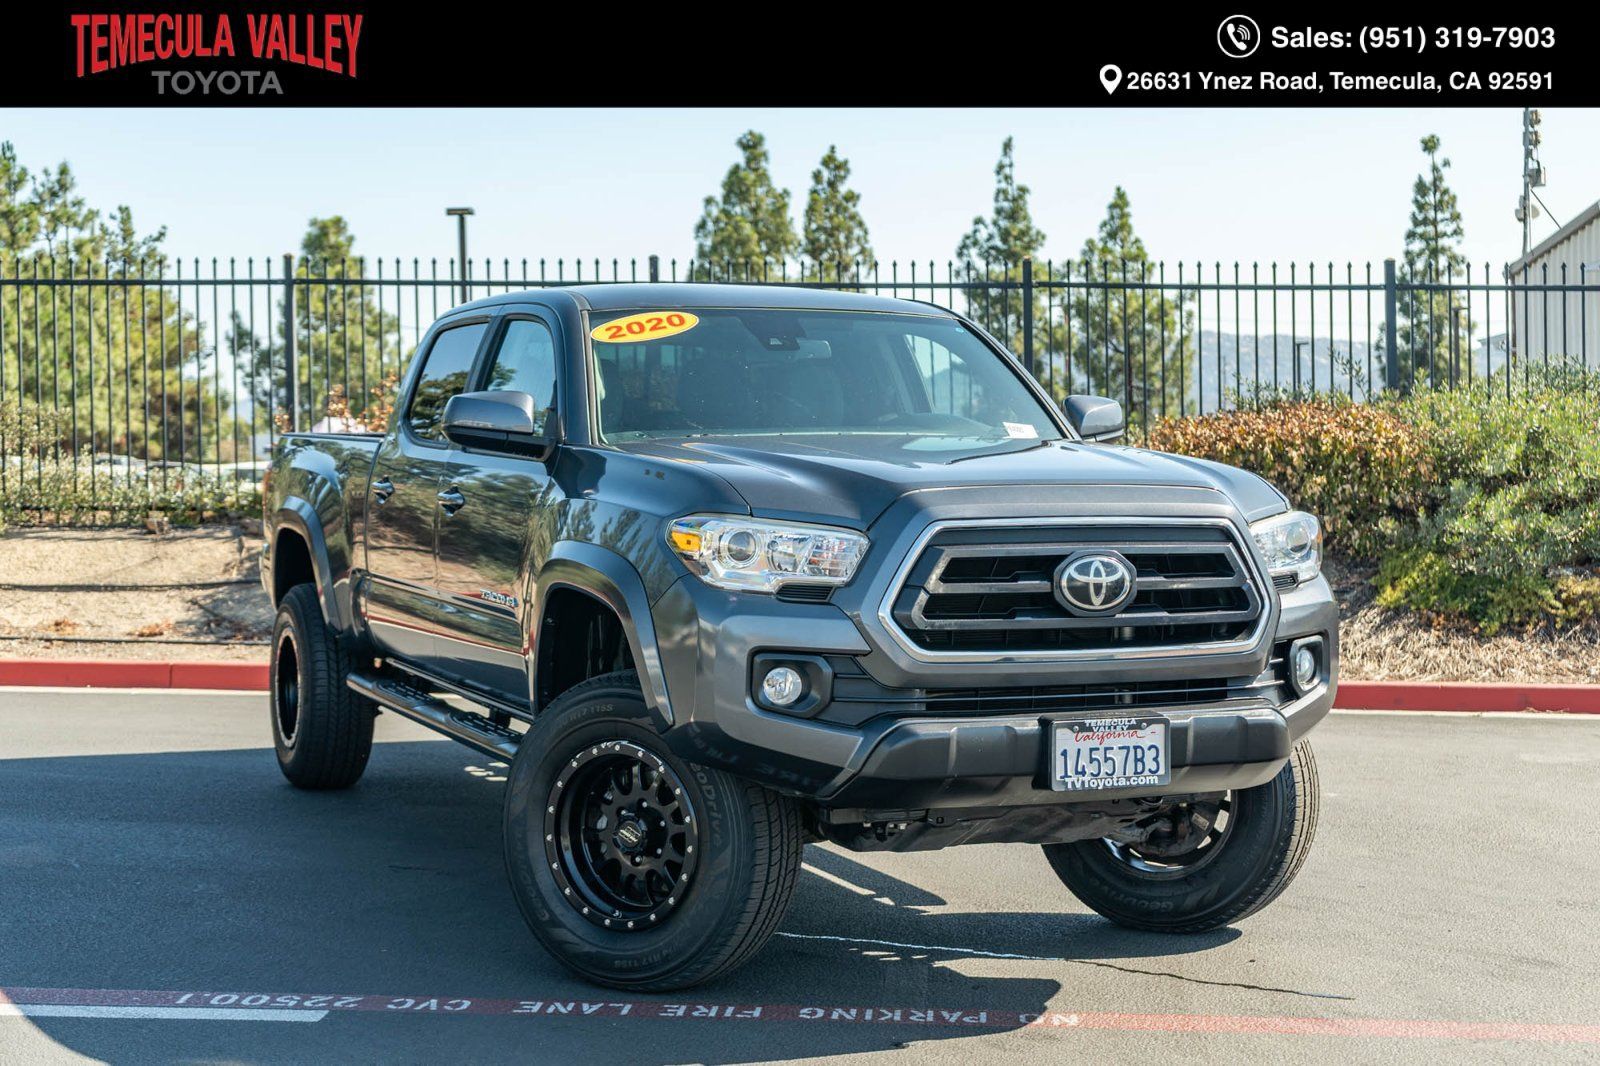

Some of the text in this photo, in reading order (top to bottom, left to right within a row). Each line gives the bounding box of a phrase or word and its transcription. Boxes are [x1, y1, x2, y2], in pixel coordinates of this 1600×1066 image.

[605, 314, 686, 339] 2020
[1084, 717, 1137, 728] TEMECULA
[1092, 724, 1128, 732] VALLEY
[1074, 729, 1145, 746] California
[1060, 744, 1160, 780] 14557B3
[1064, 774, 1159, 790] TVToyota.com
[387, 998, 472, 1011] CVC
[513, 1001, 633, 1015] LANE
[659, 1004, 763, 1018] FIRE
[799, 1007, 988, 1024] PARKING
[1019, 1012, 1079, 1025] NO
